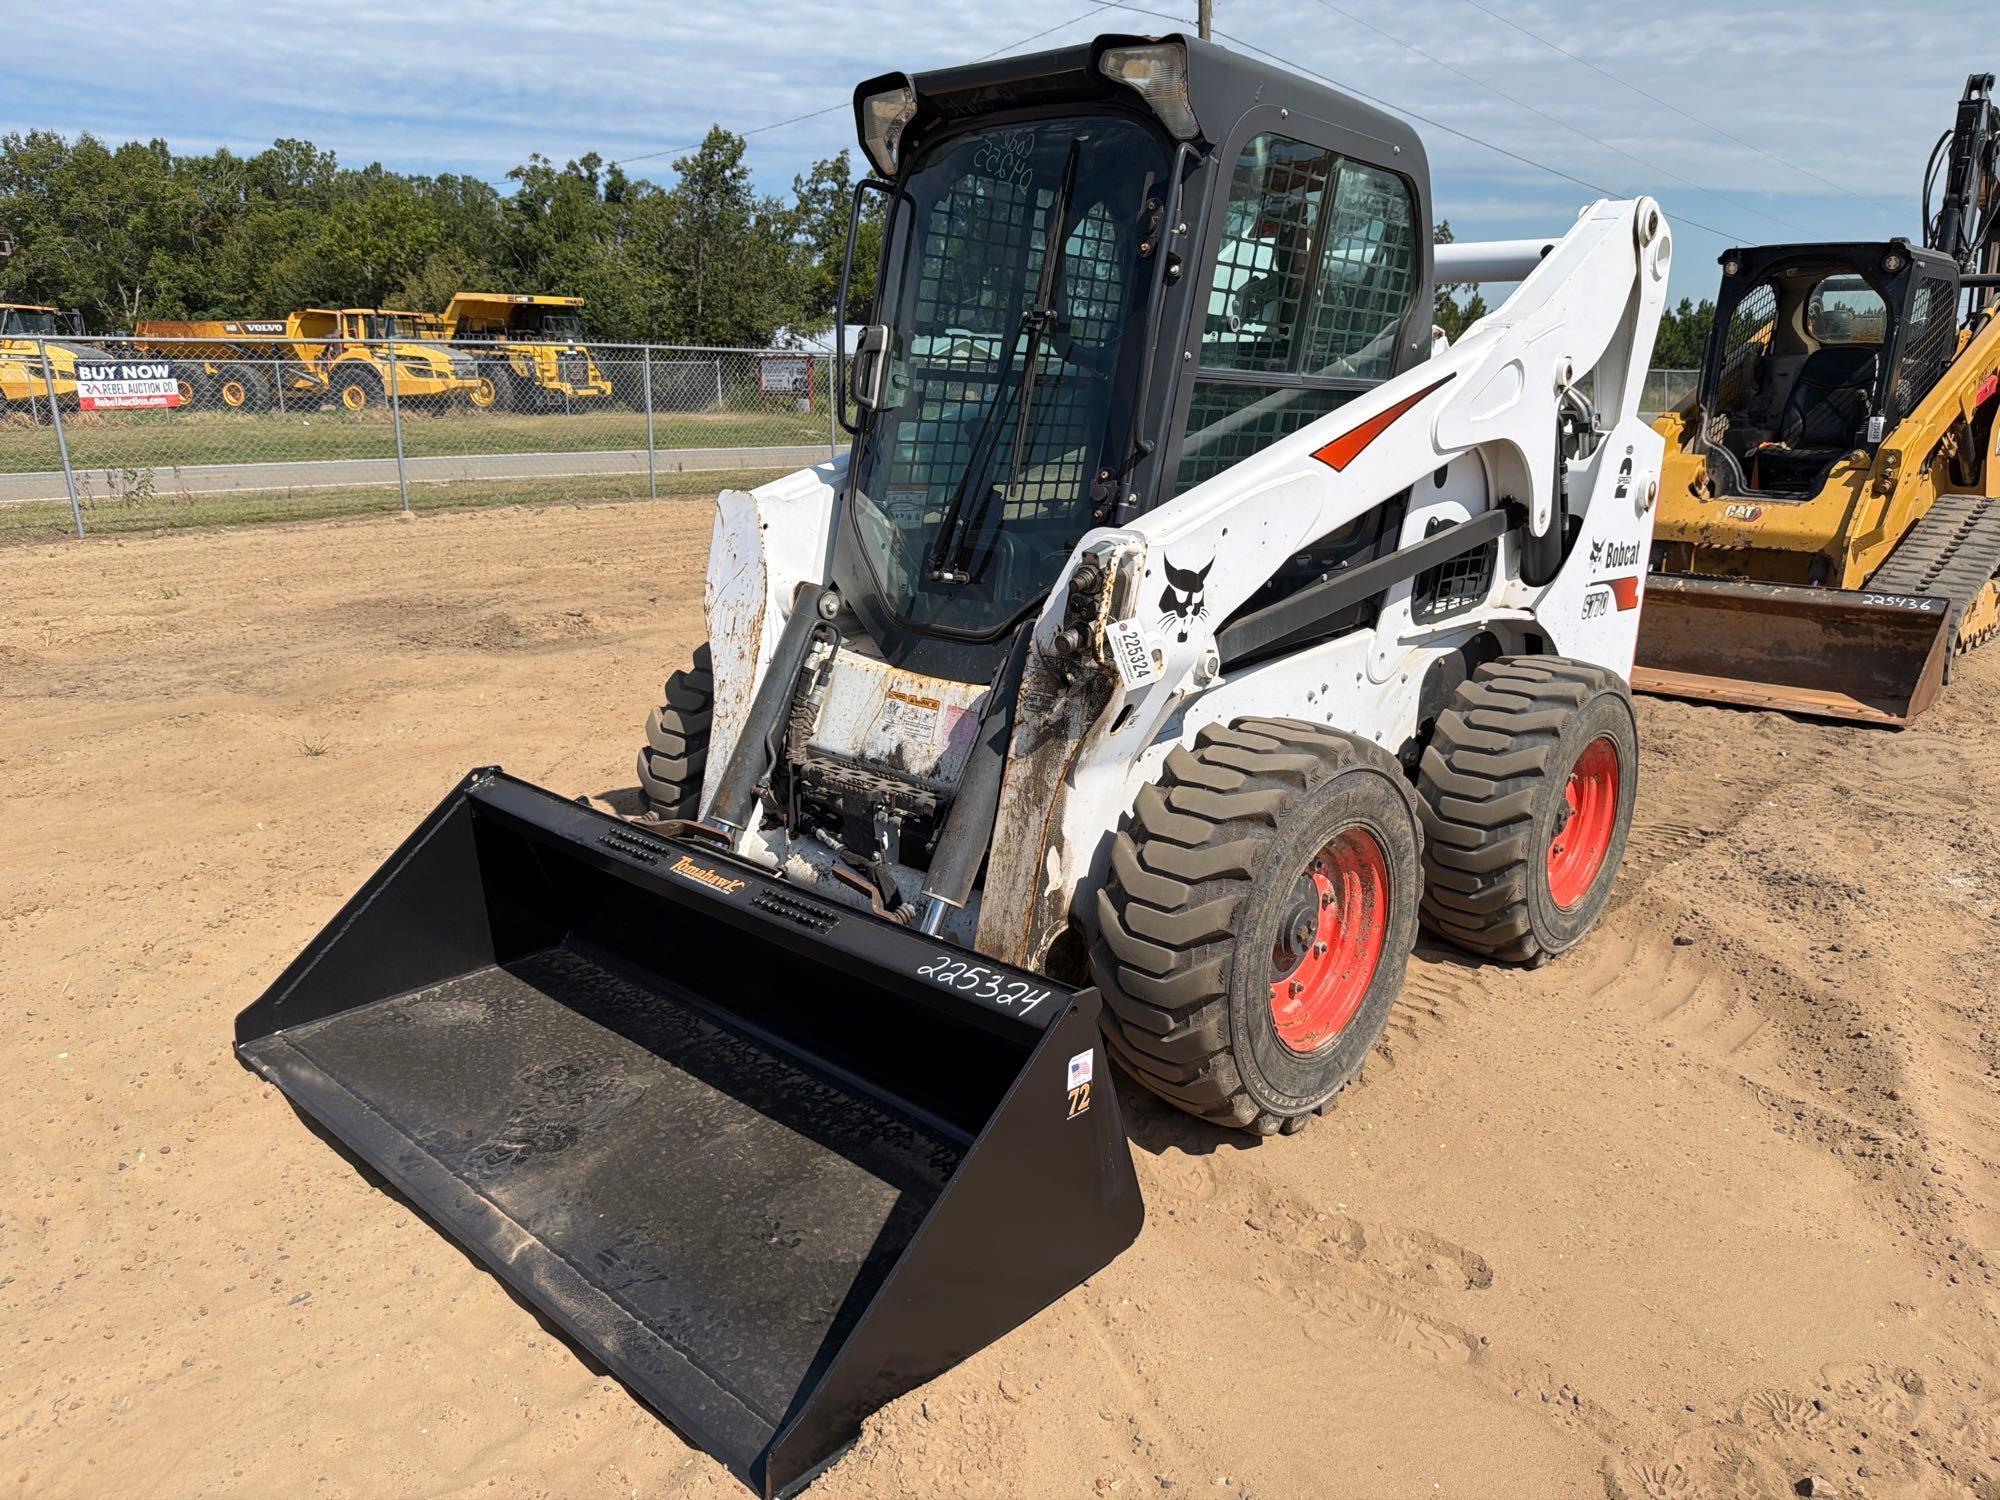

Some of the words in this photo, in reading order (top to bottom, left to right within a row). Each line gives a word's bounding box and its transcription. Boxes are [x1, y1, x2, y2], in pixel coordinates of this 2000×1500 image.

[245, 324, 283, 332] VOLVO
[78, 366, 117, 380] BUY
[122, 364, 169, 379] NOW
[102, 383, 127, 395] REBEL
[128, 382, 161, 395] AUCTION
[162, 381, 177, 393] CO.
[94, 397, 168, 407] RebelAuction.com
[1725, 505, 1756, 519] CAT
[1605, 540, 1641, 569] Bobcat
[1581, 591, 1610, 620] S770
[1862, 594, 1932, 611] 225436
[1122, 632, 1151, 678] 225324
[917, 956, 1052, 1017] 225324
[1067, 1083, 1091, 1116] 72
